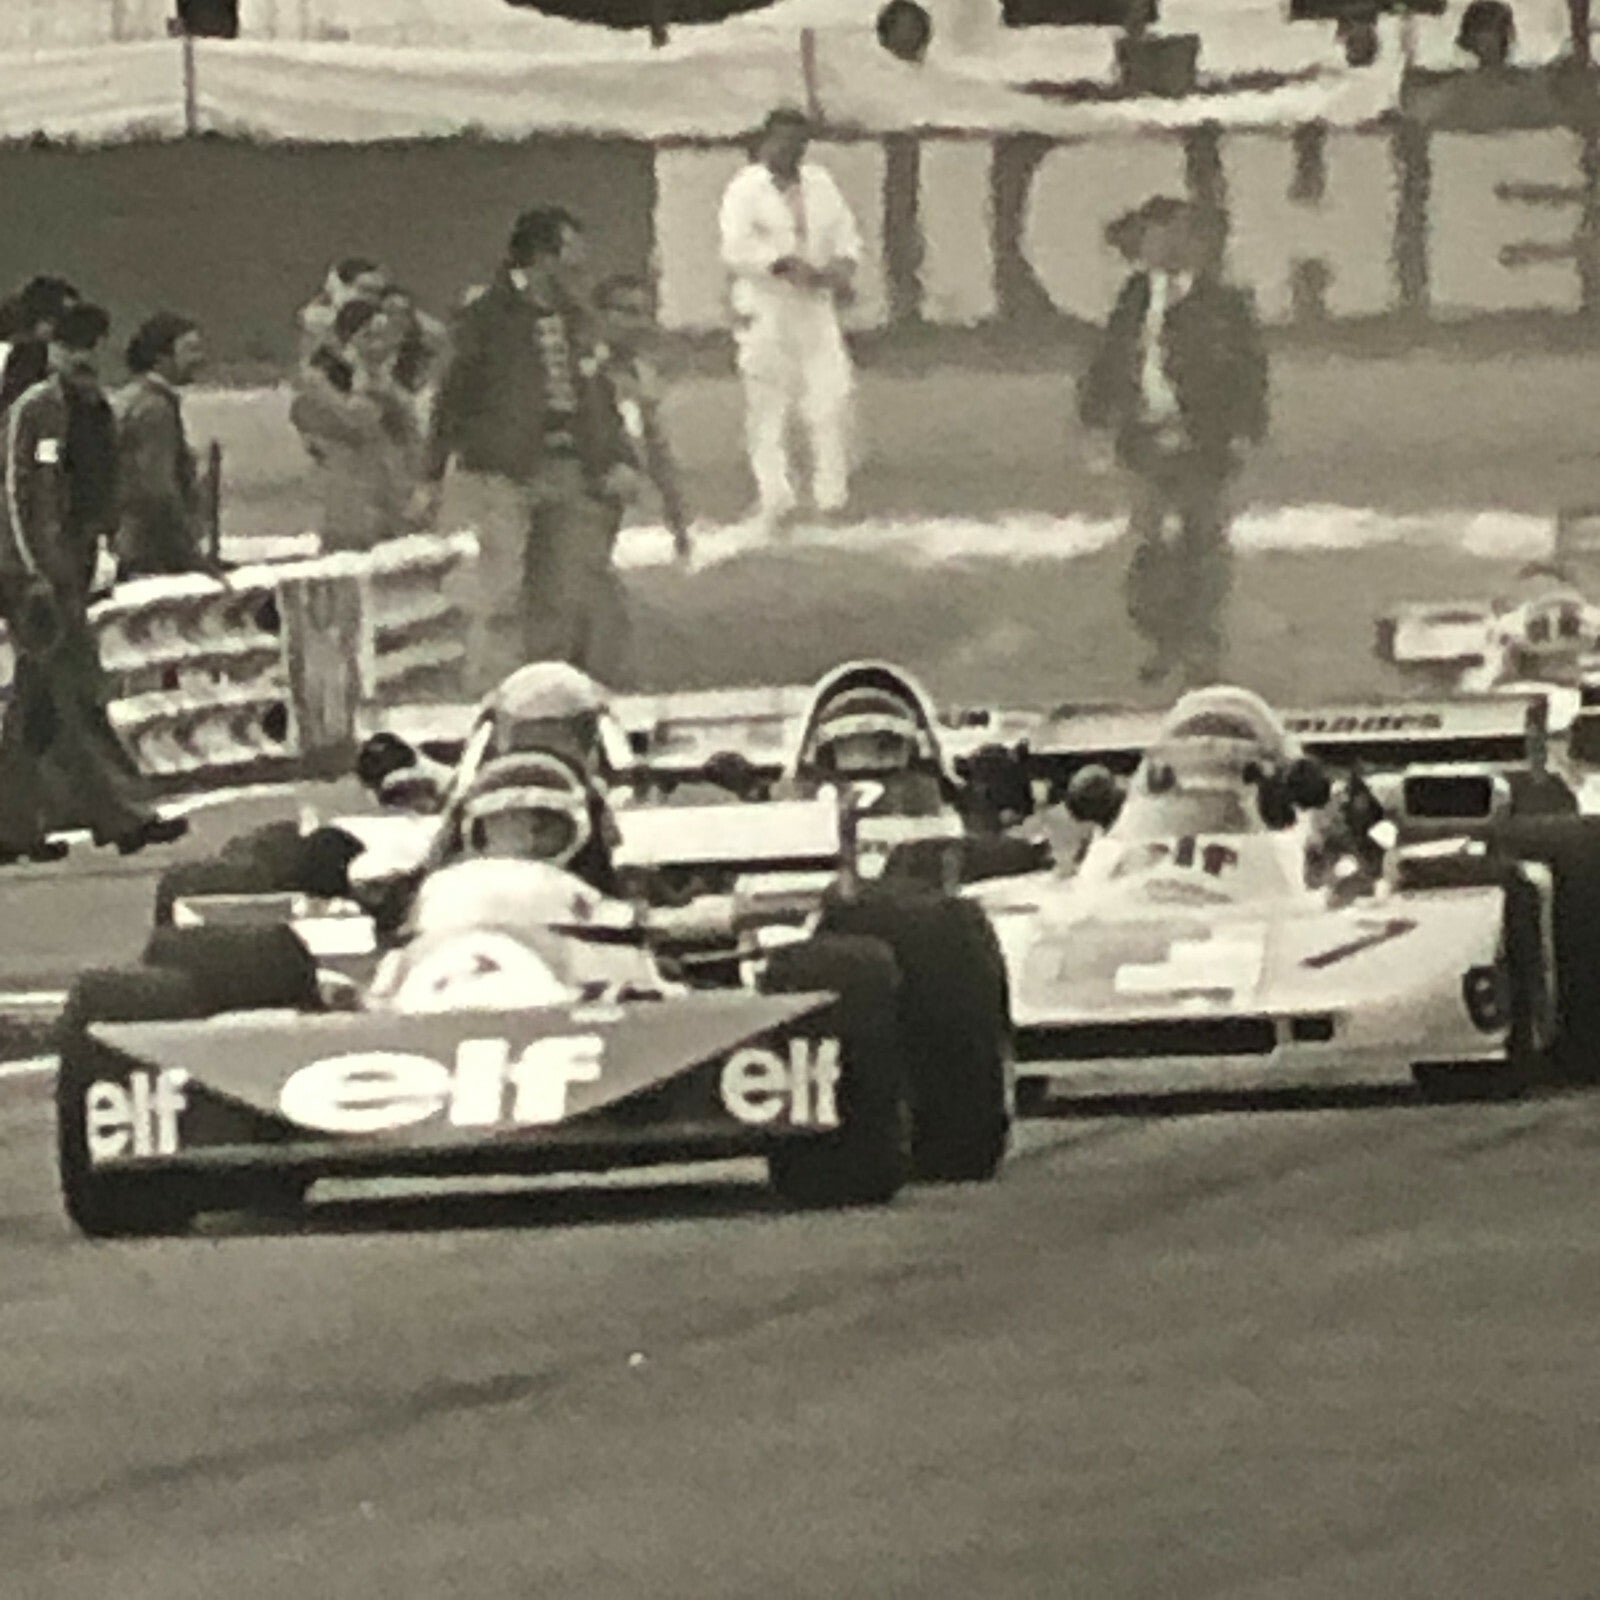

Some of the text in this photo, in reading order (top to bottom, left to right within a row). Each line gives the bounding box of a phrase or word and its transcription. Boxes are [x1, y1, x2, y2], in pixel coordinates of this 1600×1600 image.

[85, 1067, 189, 1163] elf
[279, 1034, 604, 1133] elf
[720, 1036, 841, 1127] elf
